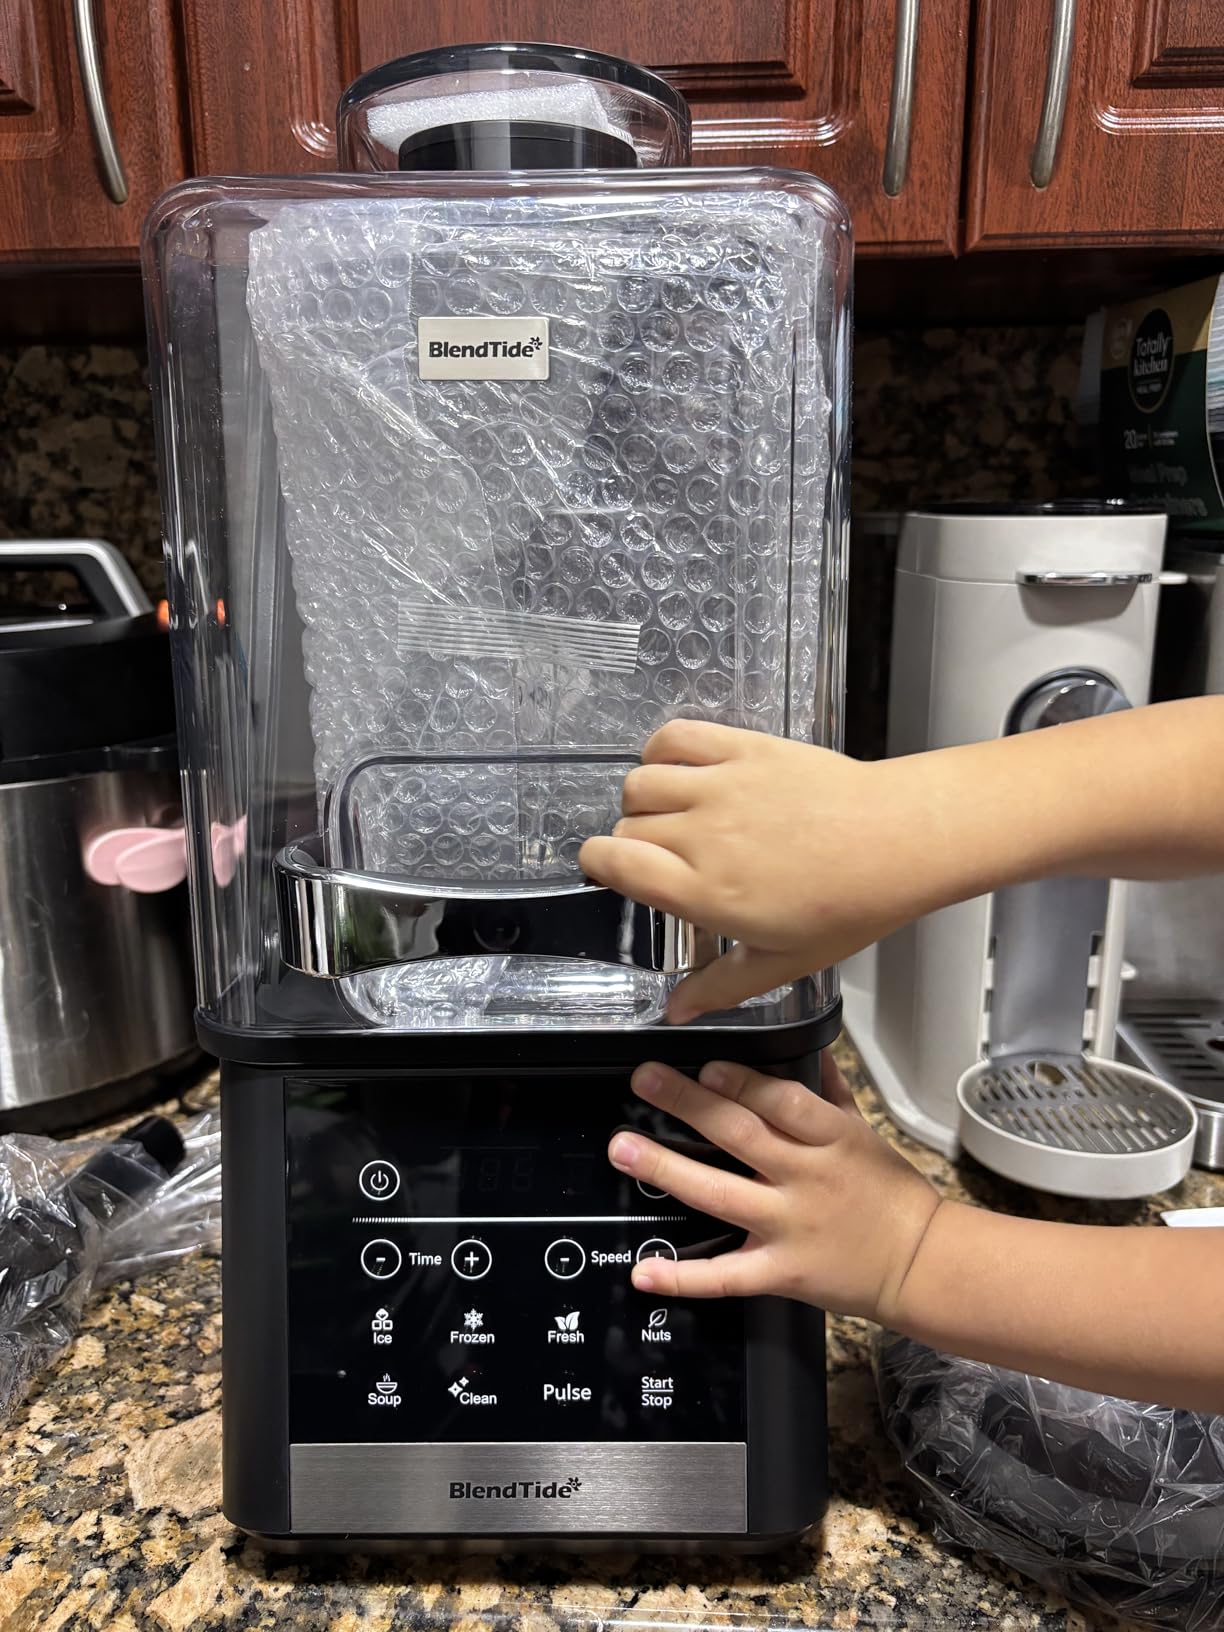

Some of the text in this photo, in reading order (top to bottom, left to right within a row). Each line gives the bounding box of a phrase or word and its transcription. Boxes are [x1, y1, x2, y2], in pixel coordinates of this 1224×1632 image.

[429, 341, 534, 358] BlendTide
[1135, 331, 1169, 358] Totally
[1133, 357, 1168, 377] kitchen
[408, 1252, 442, 1266] Time
[590, 1250, 632, 1268] Speed
[372, 1332, 393, 1345] Ice
[450, 1330, 495, 1344] Frozen
[547, 1330, 585, 1343] Fresh
[641, 1328, 672, 1342] Nuts
[641, 1376, 674, 1389] Start
[459, 1391, 498, 1405] Clean
[543, 1383, 592, 1401] Pulse
[367, 1393, 402, 1408] Soup
[641, 1393, 673, 1409] Stop
[449, 1480, 572, 1499] BlendTide
